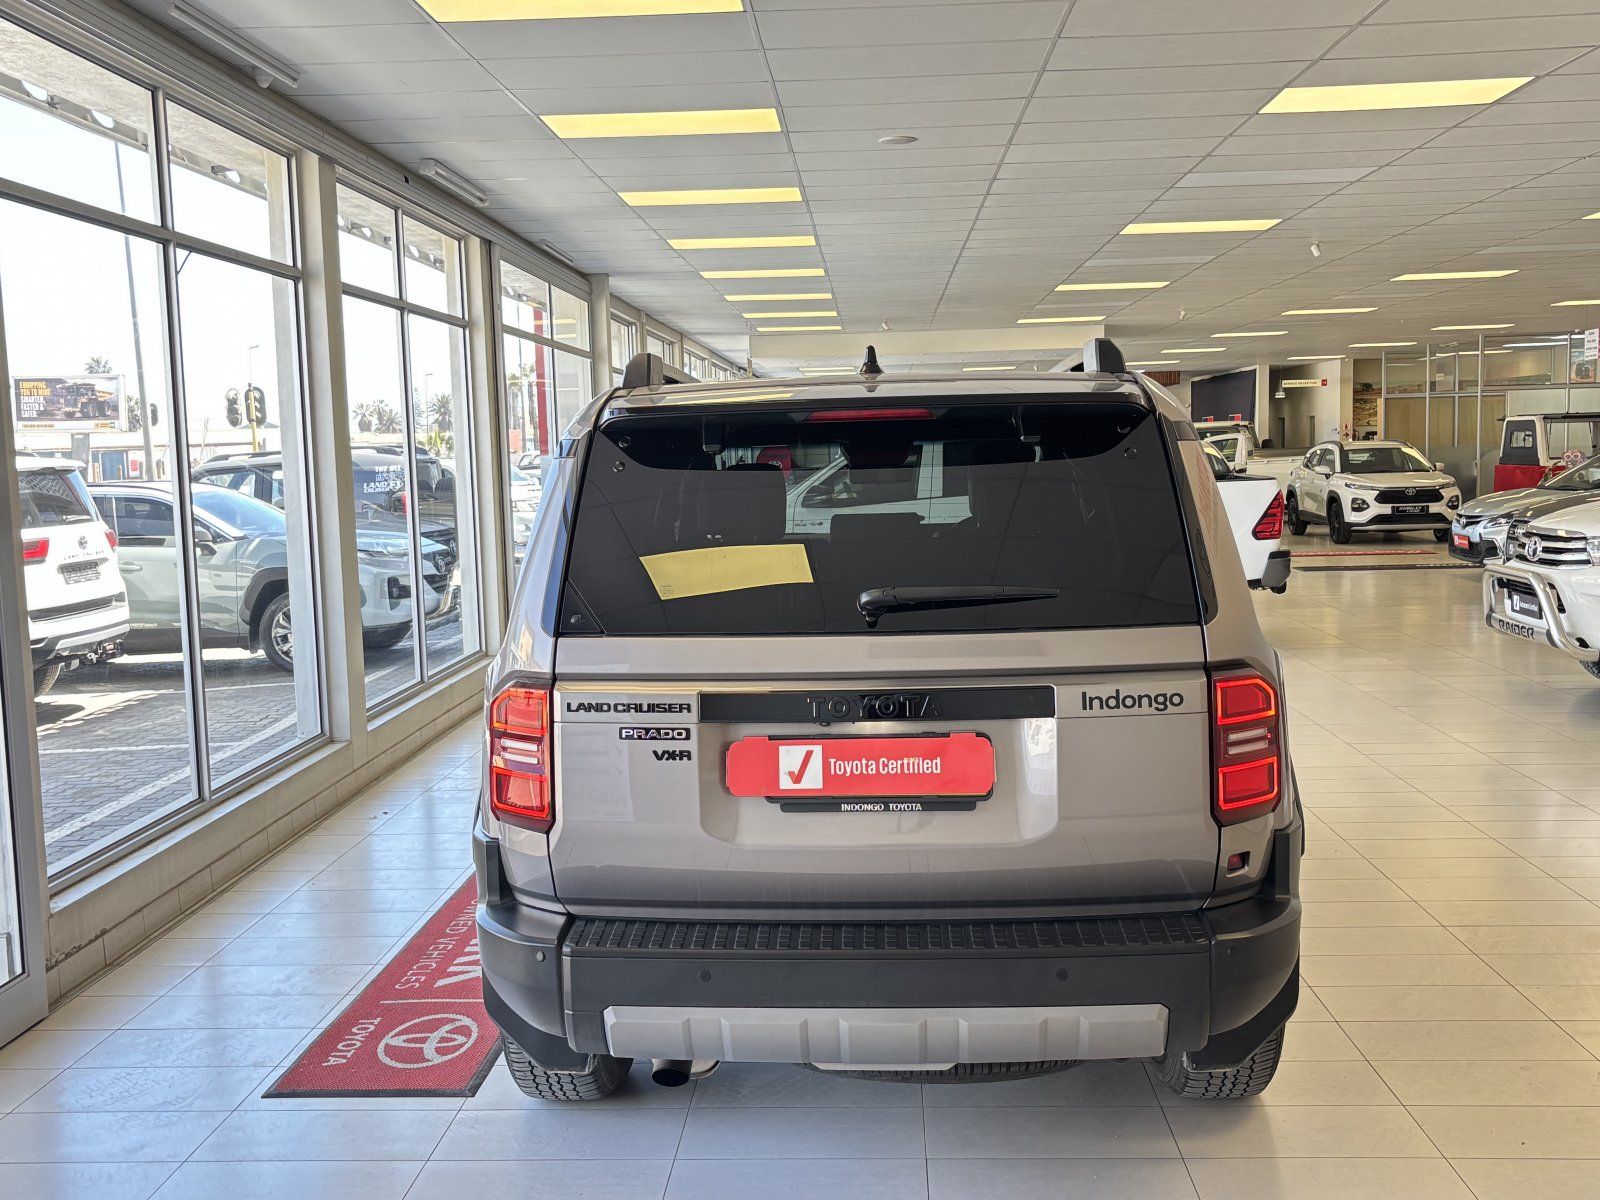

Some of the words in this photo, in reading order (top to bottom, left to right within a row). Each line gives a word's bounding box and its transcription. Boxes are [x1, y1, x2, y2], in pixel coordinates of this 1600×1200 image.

[1498, 619, 1535, 639] RAIDER
[566, 702, 611, 713] LAND
[613, 702, 692, 714] CRUISER
[806, 695, 943, 718] TOYOTA
[1081, 688, 1184, 712] Indongo
[621, 729, 687, 739] PRADO
[829, 758, 876, 776] Toyota
[879, 756, 941, 775] Certified
[841, 803, 884, 811] INDONGO
[889, 803, 922, 811] TOYOTA
[395, 937, 460, 989] VEHICLES
[322, 1017, 384, 1066] TOYOTA
